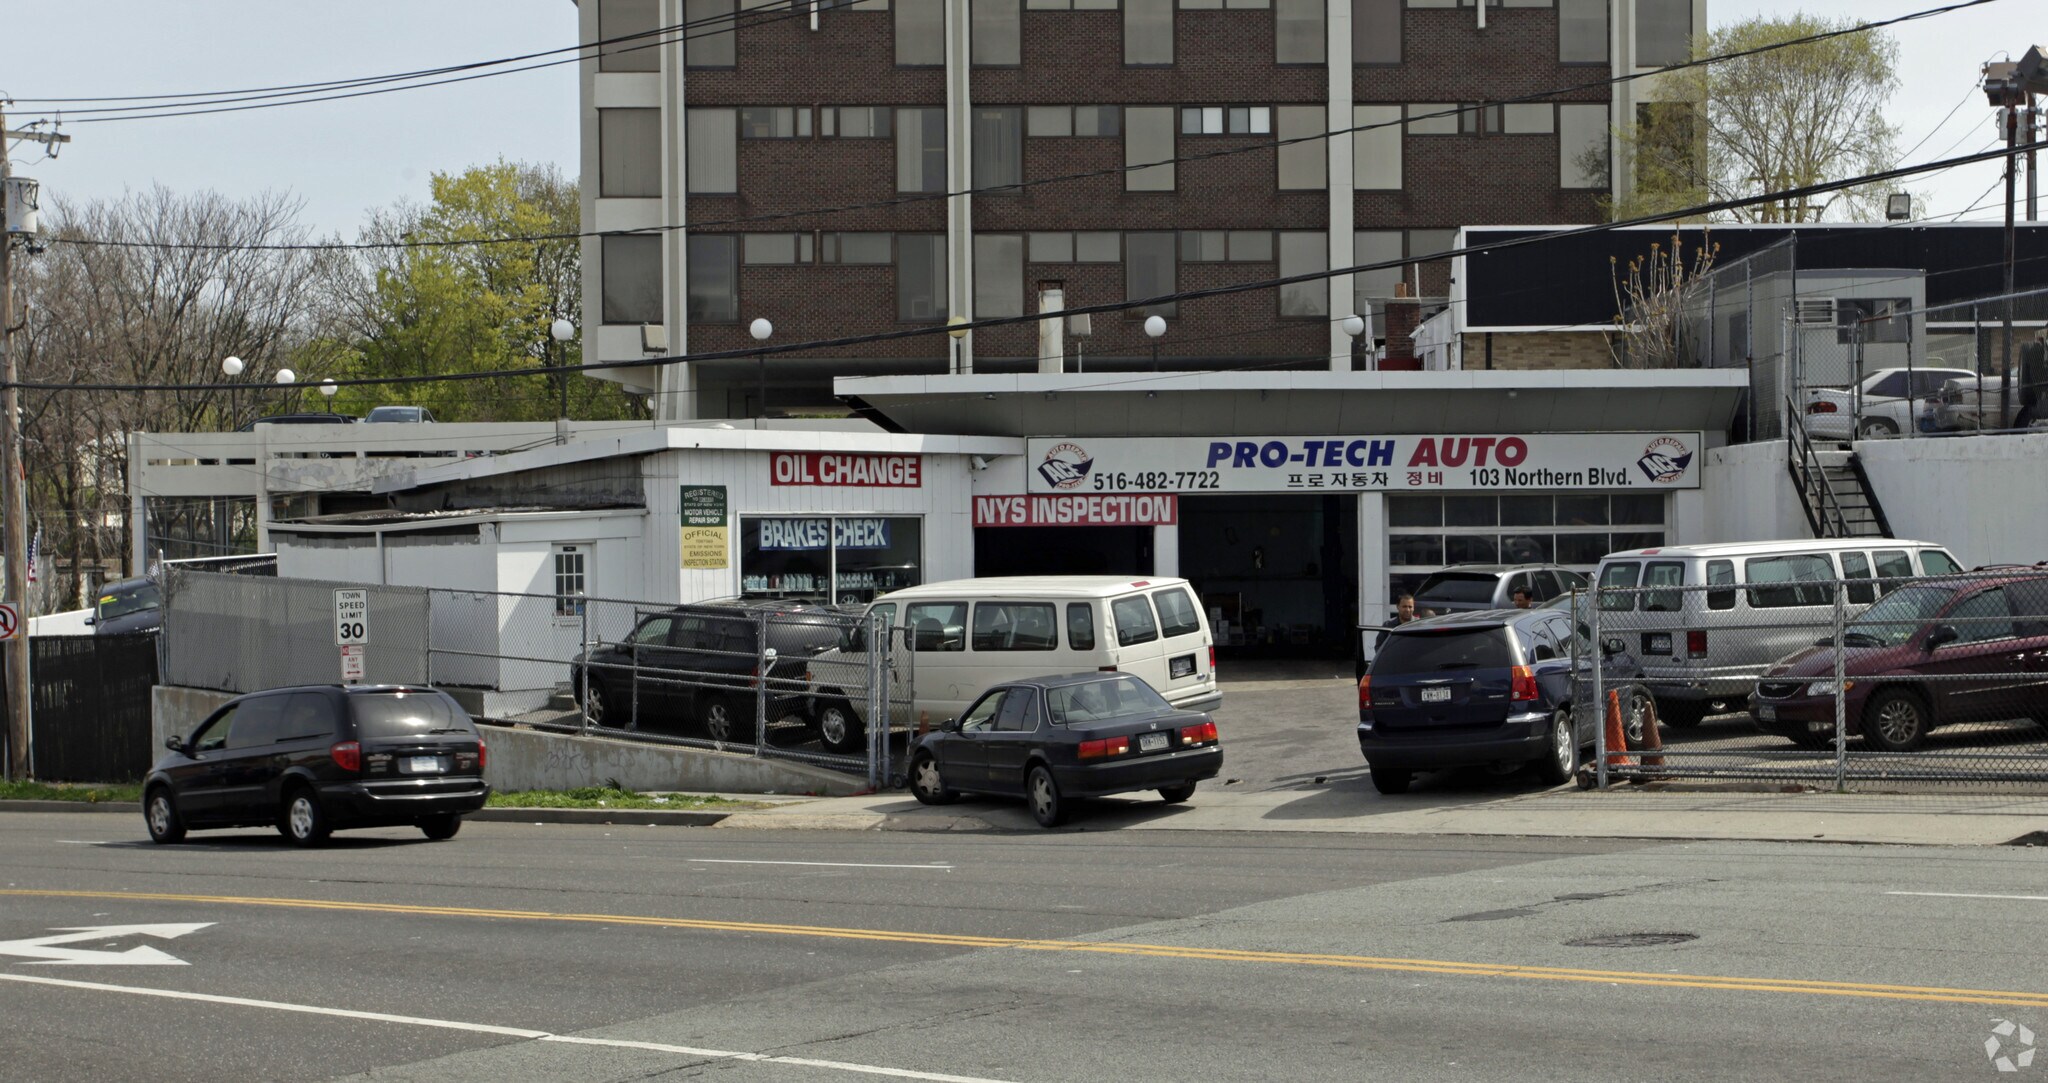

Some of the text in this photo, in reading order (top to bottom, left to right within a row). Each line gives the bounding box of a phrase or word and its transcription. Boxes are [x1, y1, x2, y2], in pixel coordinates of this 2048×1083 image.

[1206, 436, 1528, 468] PRO-TECH AUTO
[776, 454, 918, 485] OIL CHANGE
[1042, 461, 1085, 484] ACE
[1641, 455, 1684, 477] ACE
[1094, 471, 1220, 490] 516-482-7722
[1406, 471, 1443, 486] 정비
[1469, 467, 1632, 486] 103 Northern Blvd.
[684, 489, 724, 499] REGISTERED
[977, 496, 1171, 524] NYS INSPECTION
[684, 530, 724, 540] OFFICIAL
[760, 519, 887, 547] BRAKES CHECK
[684, 559, 709, 567] INSPECTION
[341, 623, 364, 638] 30
